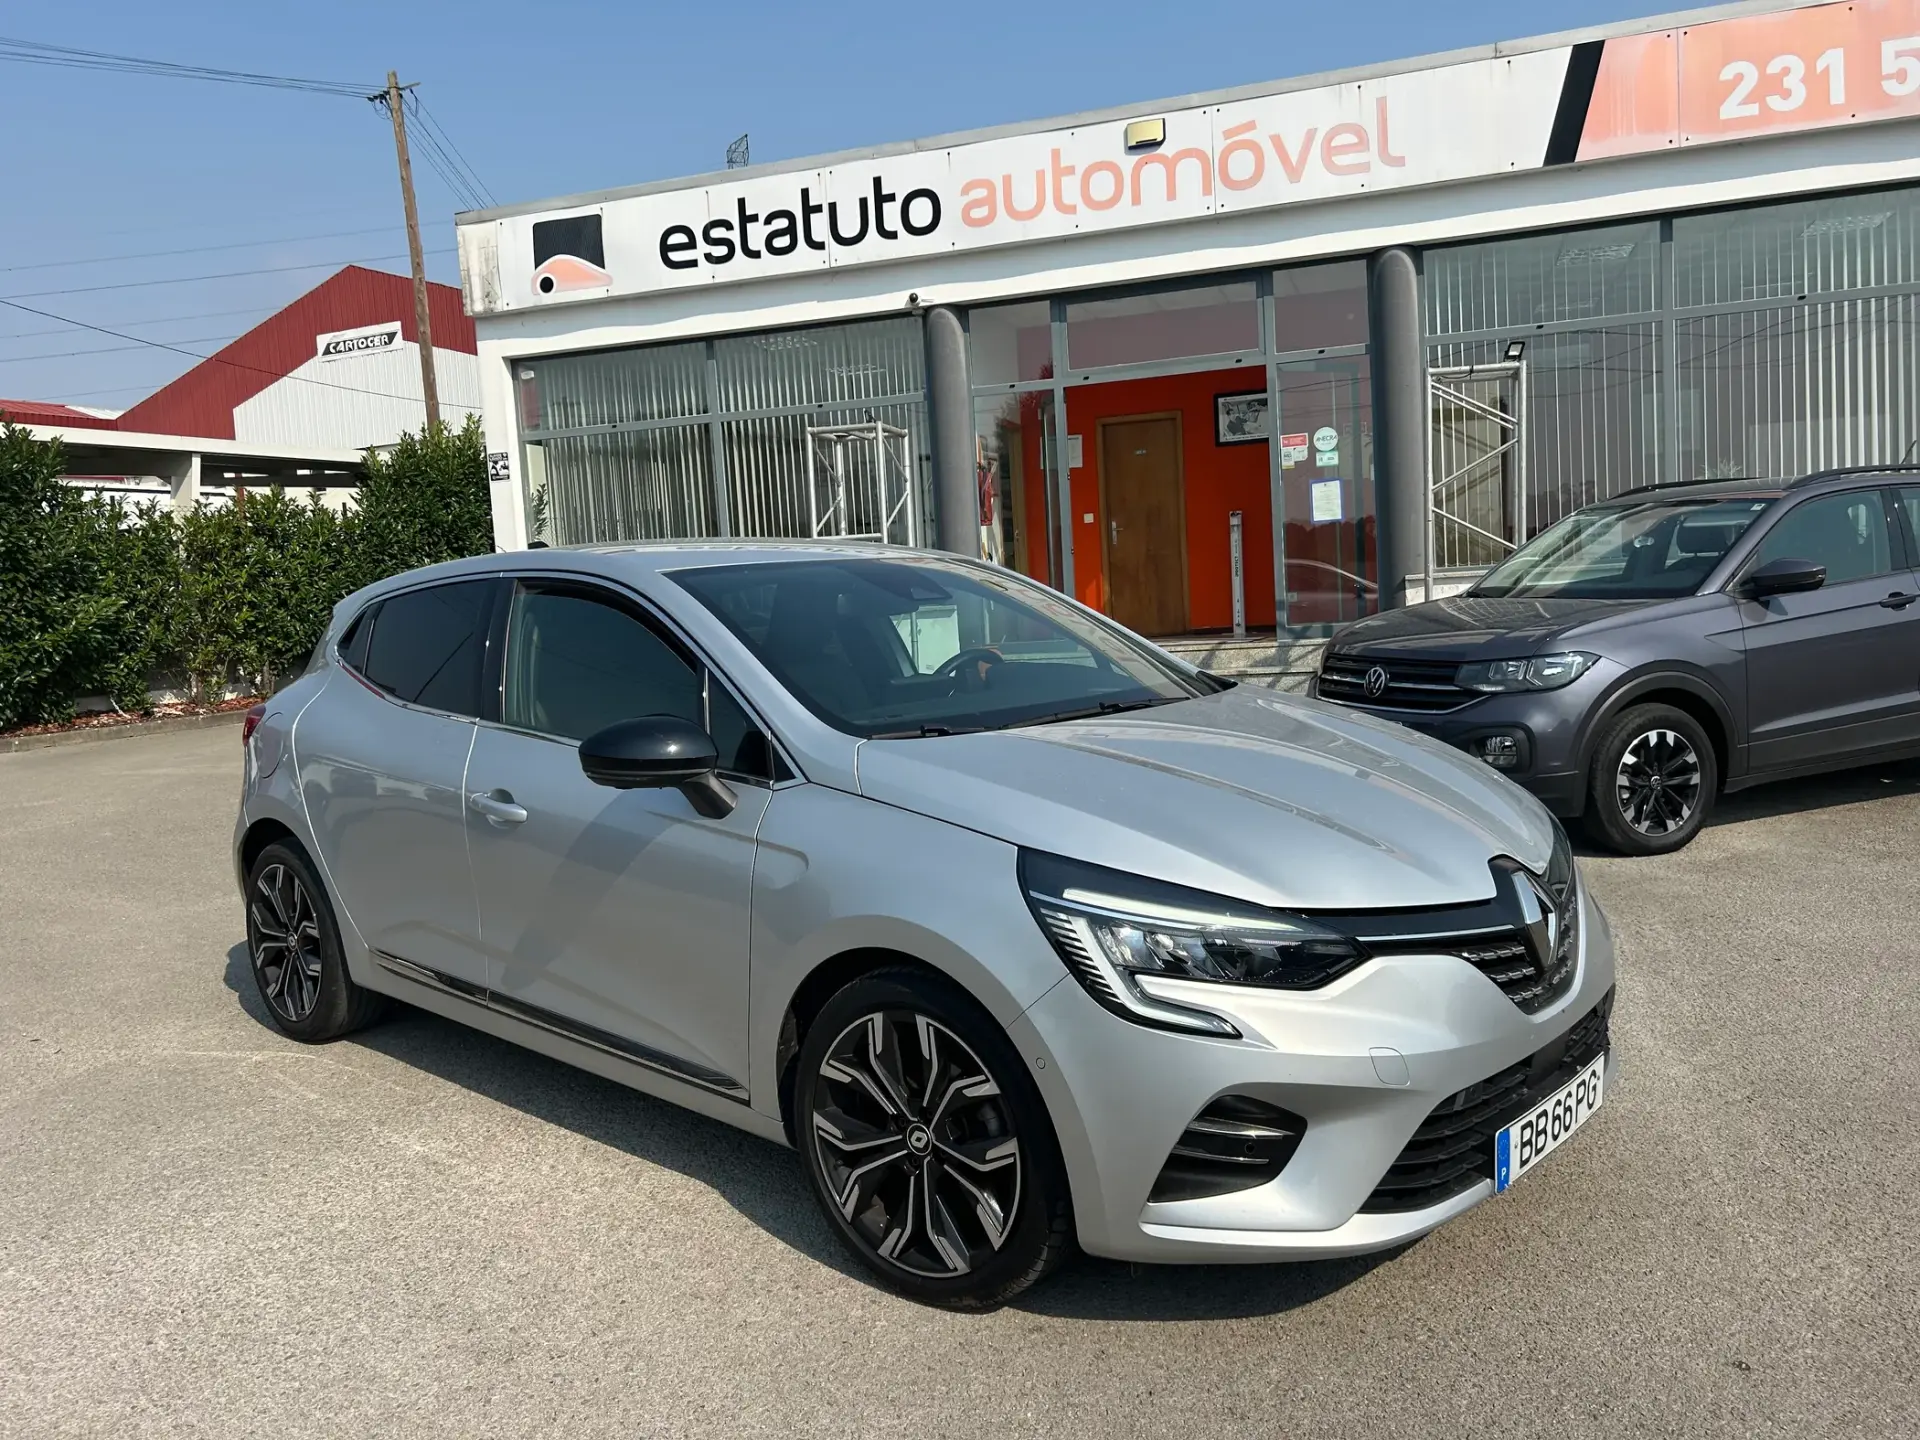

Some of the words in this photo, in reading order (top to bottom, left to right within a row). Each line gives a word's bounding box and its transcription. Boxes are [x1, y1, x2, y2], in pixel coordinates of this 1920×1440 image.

[1719, 47, 1846, 120] 231
[659, 175, 942, 270] estatuto
[959, 96, 1406, 228] automóvel
[329, 334, 389, 354] CARTOCER
[1501, 1167, 1507, 1180] P
